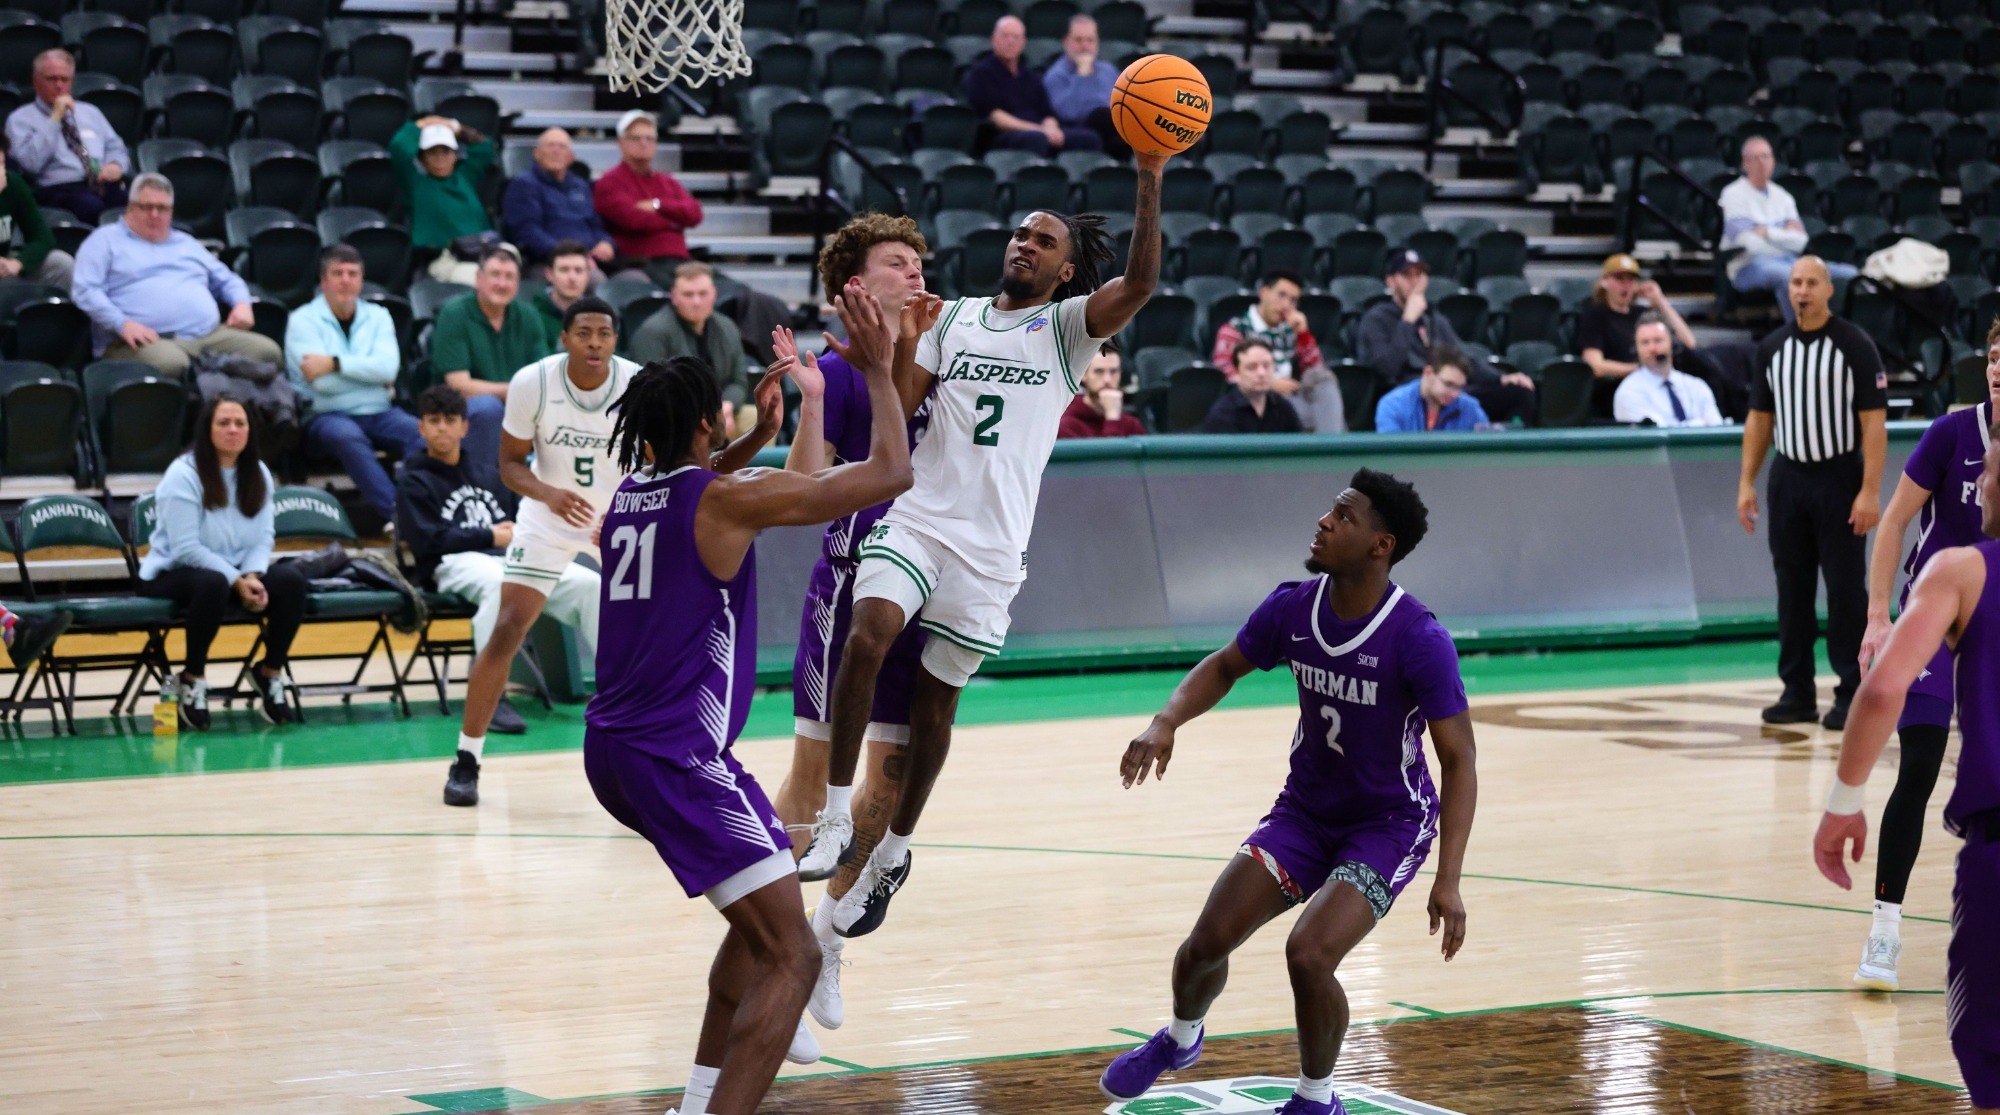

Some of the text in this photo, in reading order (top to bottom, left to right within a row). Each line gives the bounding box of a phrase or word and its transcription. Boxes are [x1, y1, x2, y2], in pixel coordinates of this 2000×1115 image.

[1176, 90, 1210, 114] NCAA
[941, 357, 1051, 386] JASPERS
[973, 394, 1005, 447] 2
[545, 430, 621, 450] JASPE
[574, 456, 594, 488] 5
[274, 497, 340, 521] ANHATTAN
[613, 487, 671, 514] BOWSER
[30, 502, 107, 529] MANHATTAN
[609, 521, 658, 601] 21
[1291, 659, 1379, 706] FURMAN
[1320, 704, 1345, 757] 2
